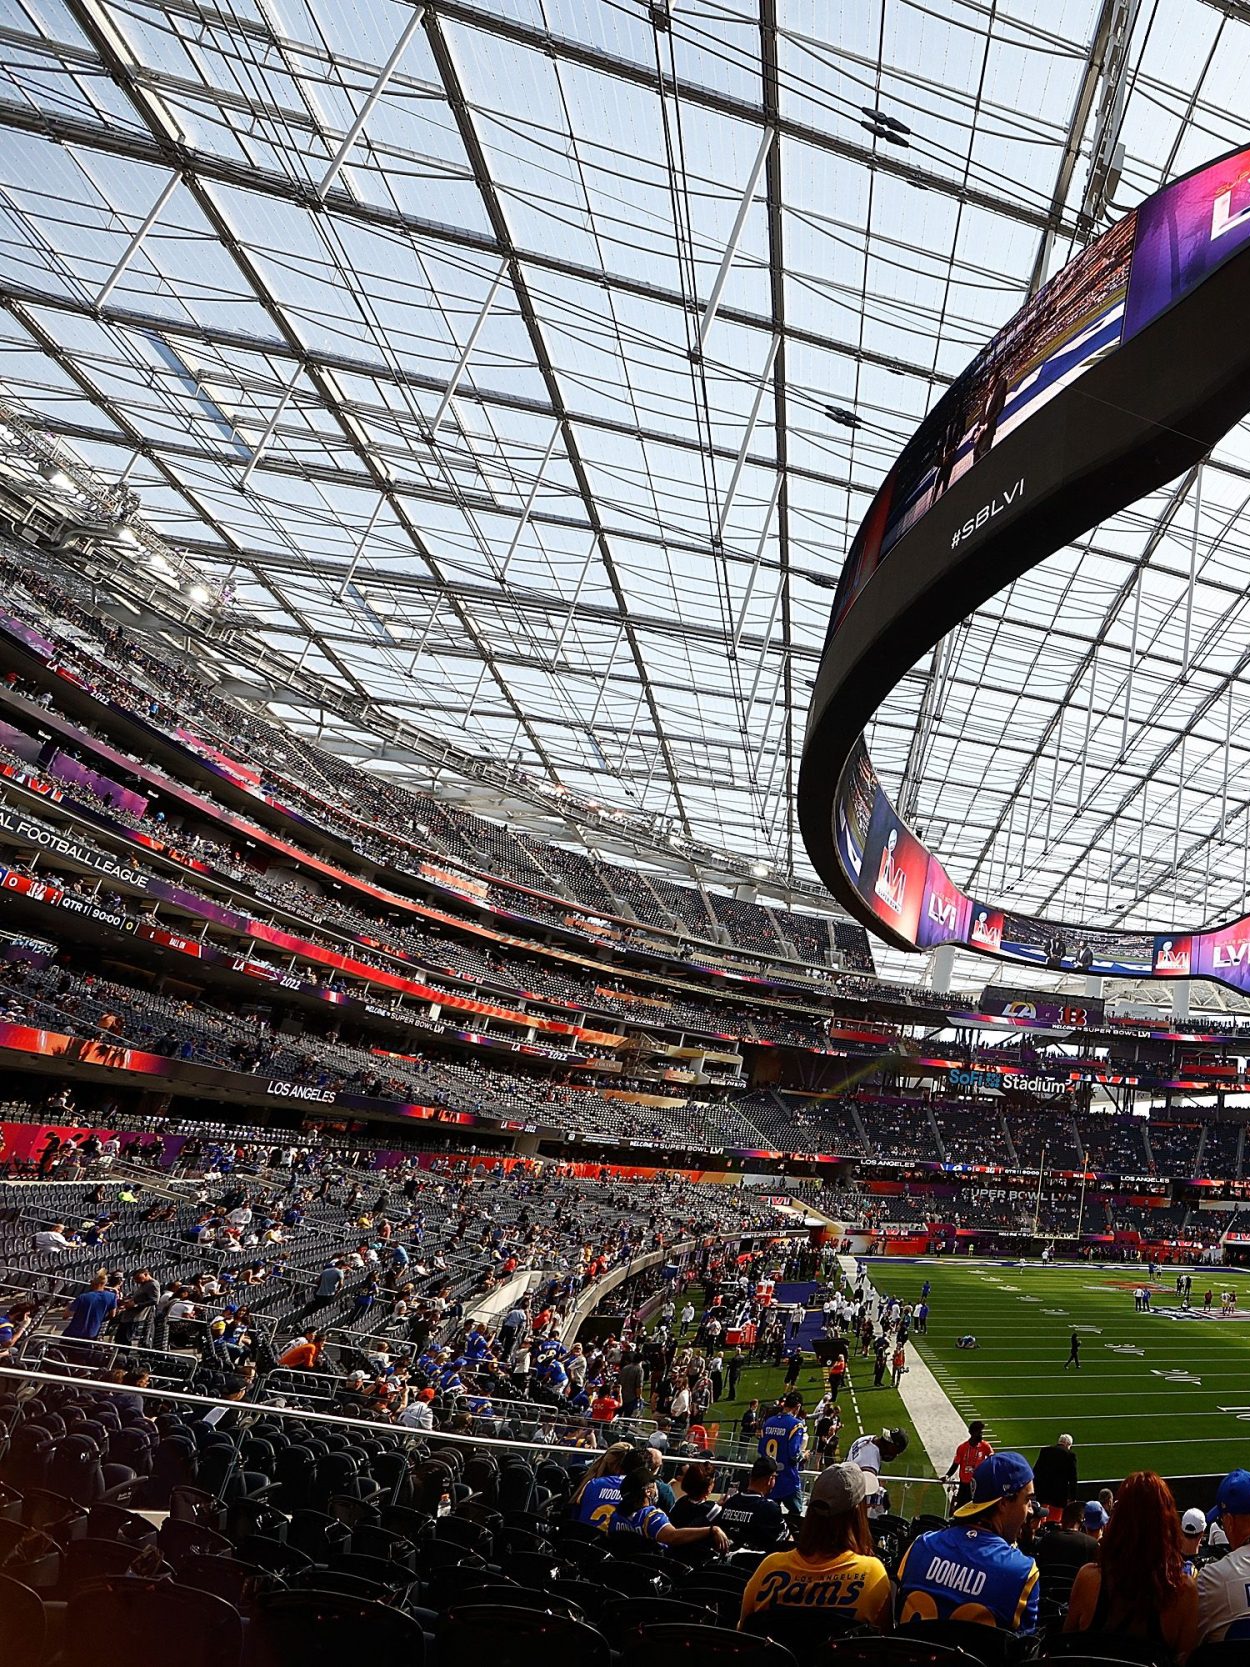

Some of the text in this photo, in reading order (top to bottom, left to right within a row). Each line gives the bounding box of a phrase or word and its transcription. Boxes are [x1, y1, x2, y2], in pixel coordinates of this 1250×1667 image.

[951, 477, 1025, 549] #SBLVI
[17, 821, 149, 889] FOOTBALL LEAGUE
[62, 897, 82, 912] QTR
[92, 909, 121, 926] 90:00
[928, 892, 957, 931] LVI
[232, 959, 301, 990] LA 2022
[391, 1012, 414, 1025] SUPER
[414, 1019, 434, 1031] BOWL
[434, 1024, 445, 1035] LVI
[1112, 1029, 1137, 1037] BOWL
[267, 1080, 336, 1104] LOS ANGELES
[950, 1069, 984, 1087] SoFi
[1002, 1073, 1066, 1094] Stadium
[659, 1143, 686, 1151] SUPER
[687, 1145, 709, 1153] BOWL
[709, 1147, 724, 1155] LVI
[882, 1160, 915, 1168] ANGELES
[1009, 1190, 1048, 1201] BOWL
[765, 1425, 786, 1436] STAFFORD
[765, 1439, 778, 1464] 9
[598, 1487, 624, 1501] WOOD
[721, 1508, 754, 1523] PRESCOTT
[793, 1573, 866, 1583] LOS ANGELES
[926, 1556, 988, 1596] DONALD
[756, 1570, 866, 1607] Rams
